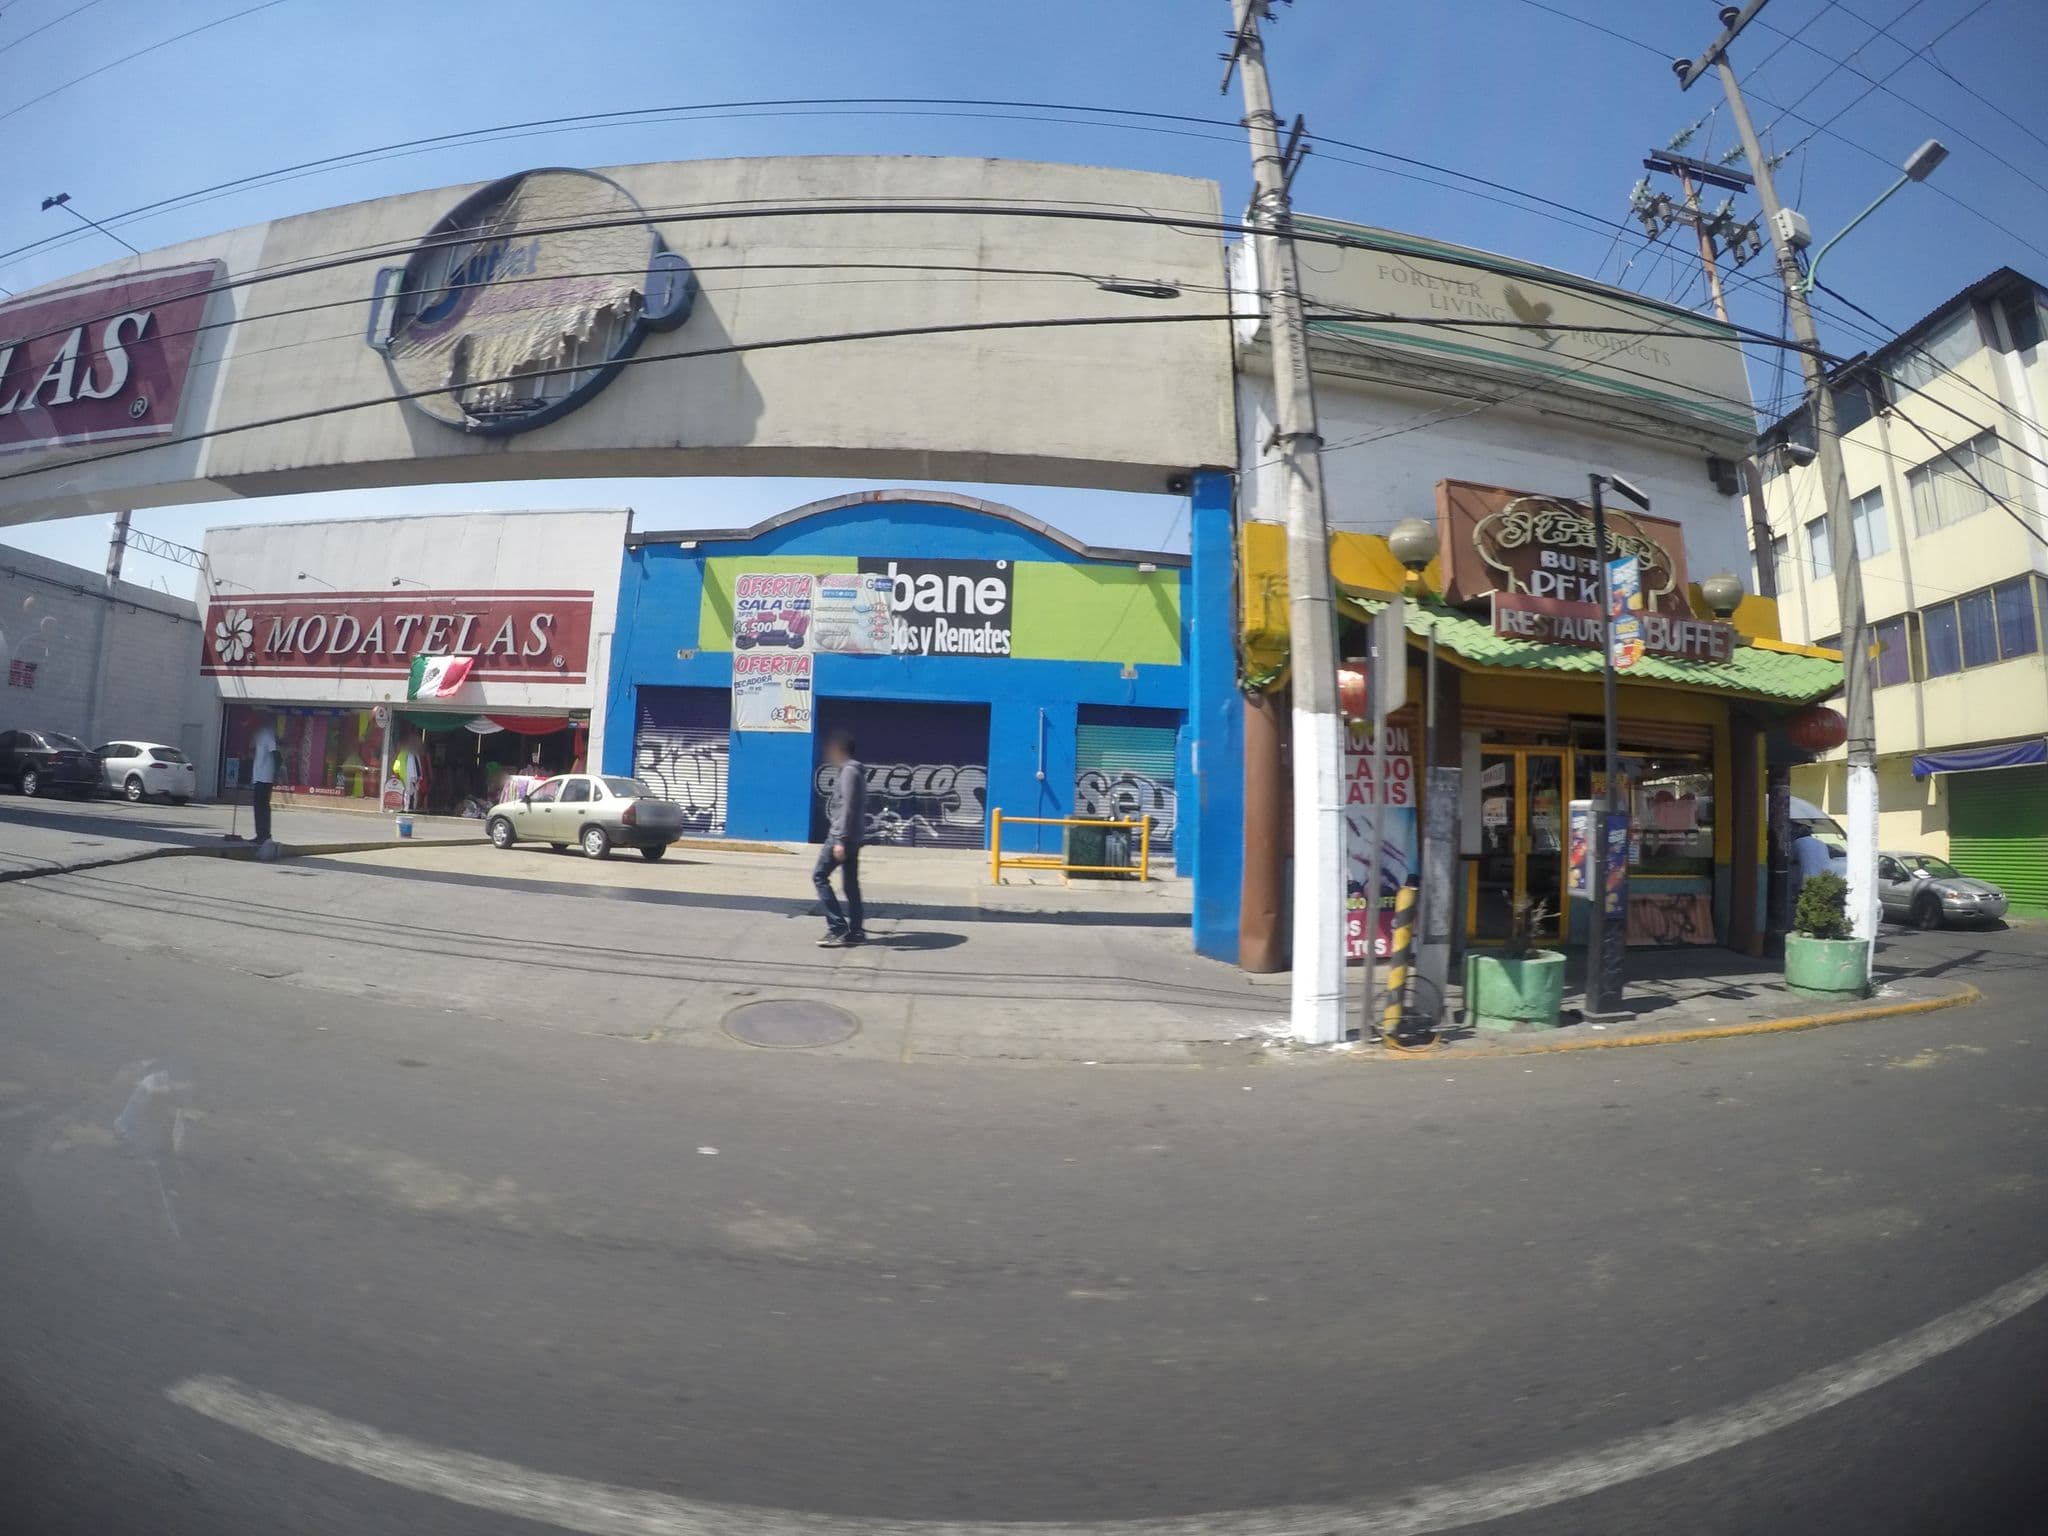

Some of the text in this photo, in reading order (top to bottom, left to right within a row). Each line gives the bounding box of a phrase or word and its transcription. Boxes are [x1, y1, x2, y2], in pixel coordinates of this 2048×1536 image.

[1378, 265, 1482, 299] FOREVER
[1429, 293, 1506, 322] LIVING
[1570, 329, 1672, 367] PRODUCTS
[736, 575, 813, 598] OFERTA
[738, 600, 782, 610] SALA
[264, 614, 554, 656] MODATELAS
[920, 626, 932, 656] y
[935, 618, 1011, 654] Remates
[734, 653, 811, 676] OFERTA
